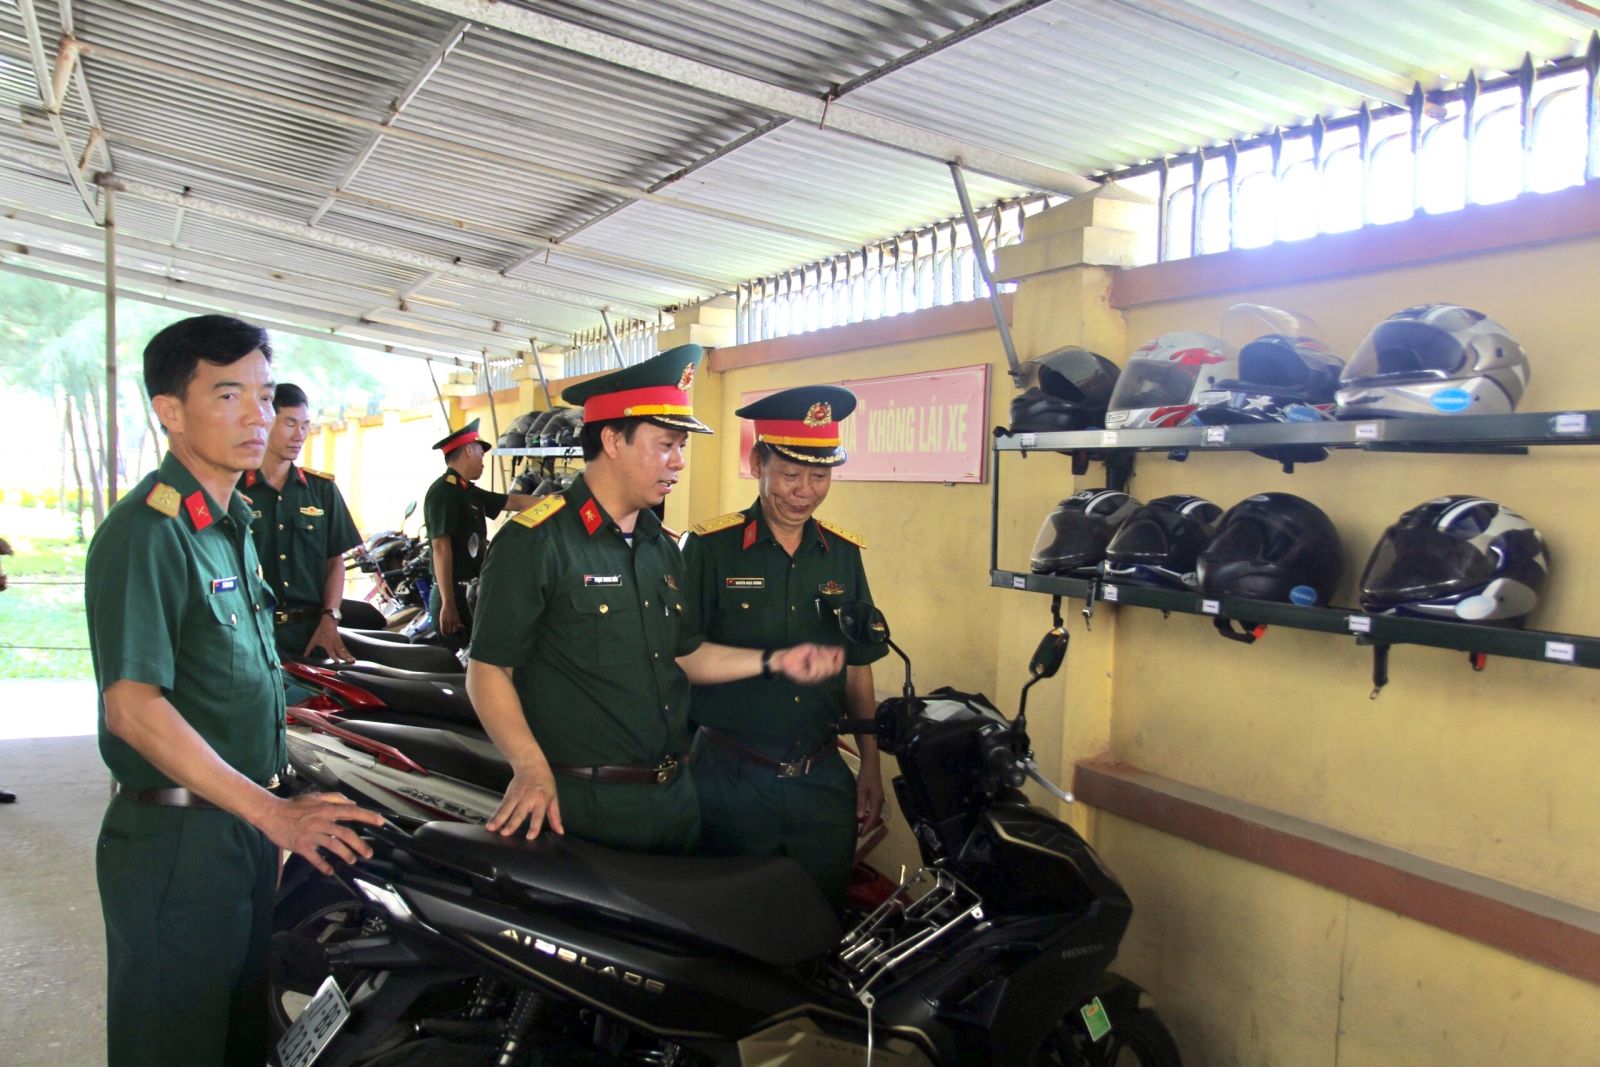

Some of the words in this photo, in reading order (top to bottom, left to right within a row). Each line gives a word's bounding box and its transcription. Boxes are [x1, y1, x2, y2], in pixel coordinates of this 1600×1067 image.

[867, 400, 915, 453] KHÔNG
[919, 395, 943, 452] LÁI
[947, 404, 968, 452] XE
[1061, 942, 1104, 959] HONDA
